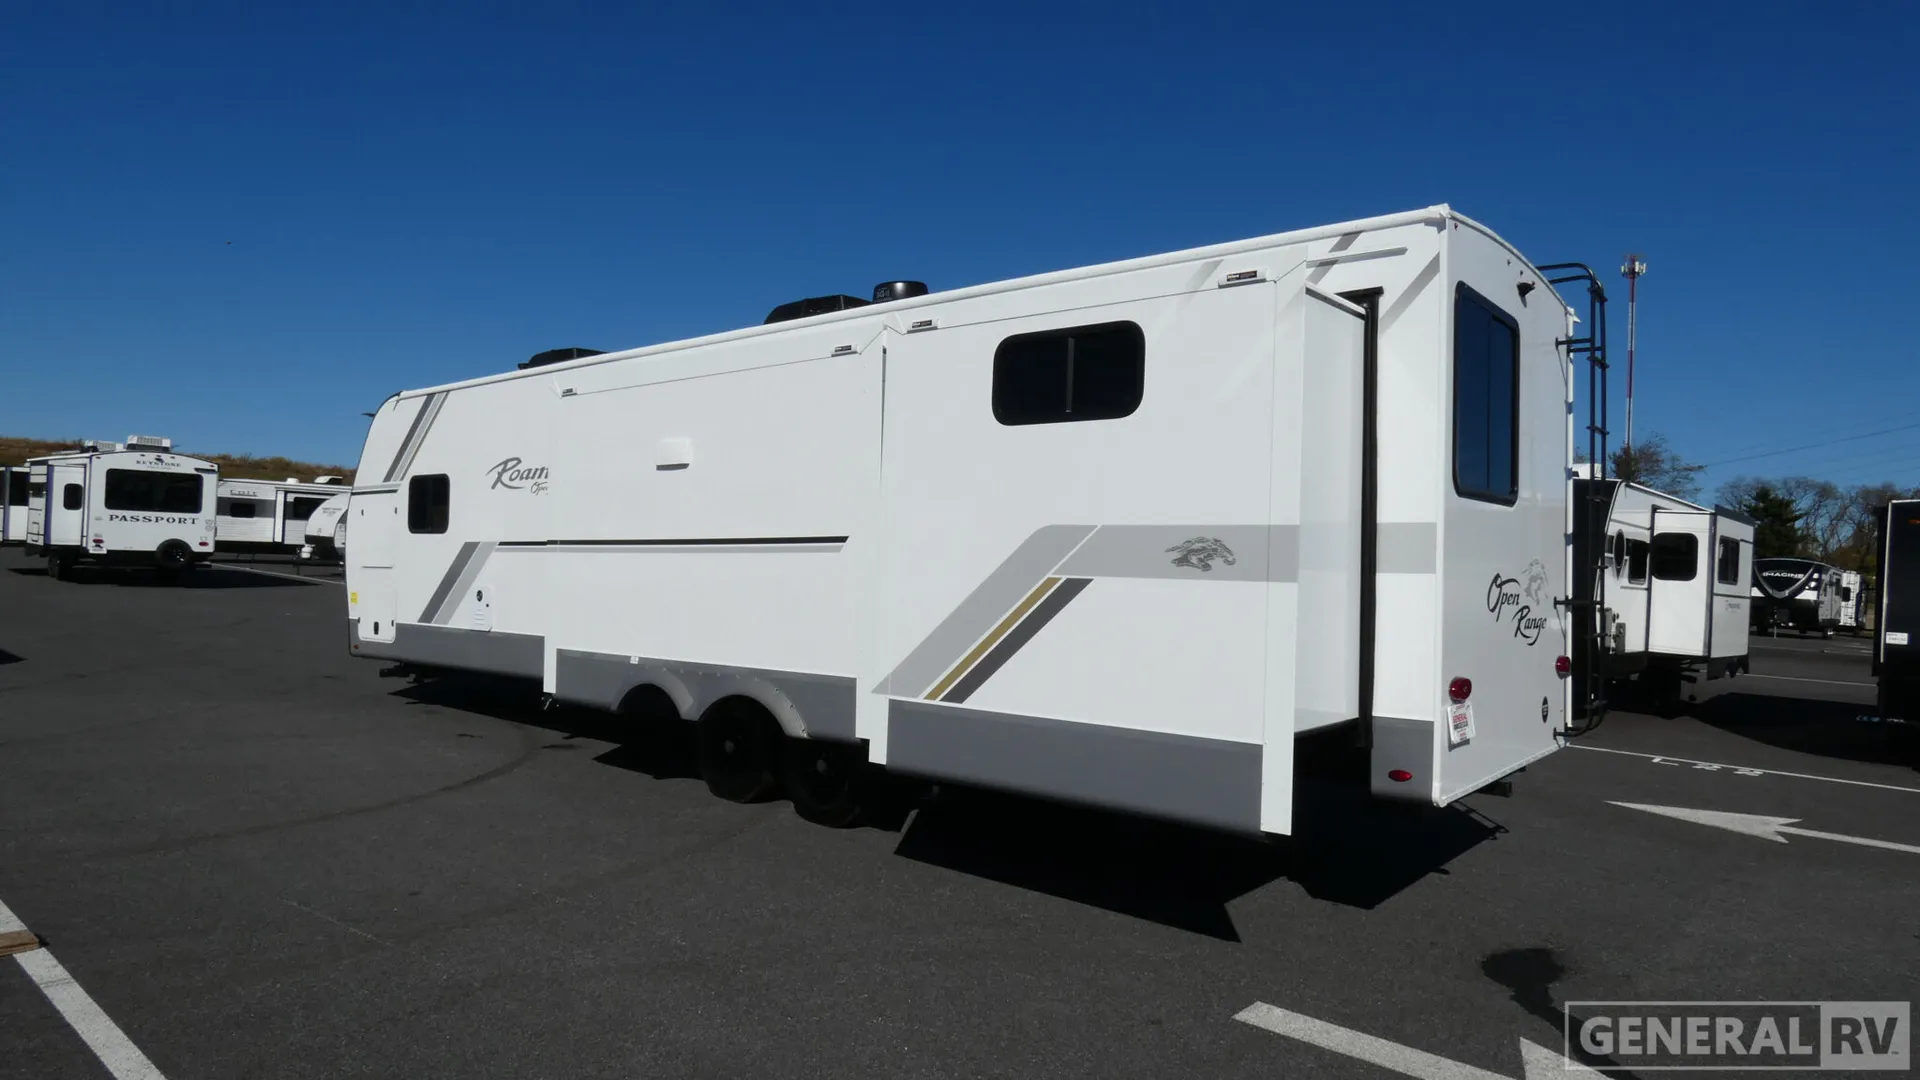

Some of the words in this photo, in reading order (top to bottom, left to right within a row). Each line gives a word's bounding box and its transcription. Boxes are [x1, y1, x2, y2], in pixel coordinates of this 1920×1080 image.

[109, 514, 199, 525] PASSPORT
[1762, 571, 1805, 579] IMAGINE
[1487, 572, 1520, 622] Open
[1512, 605, 1548, 646] Range
